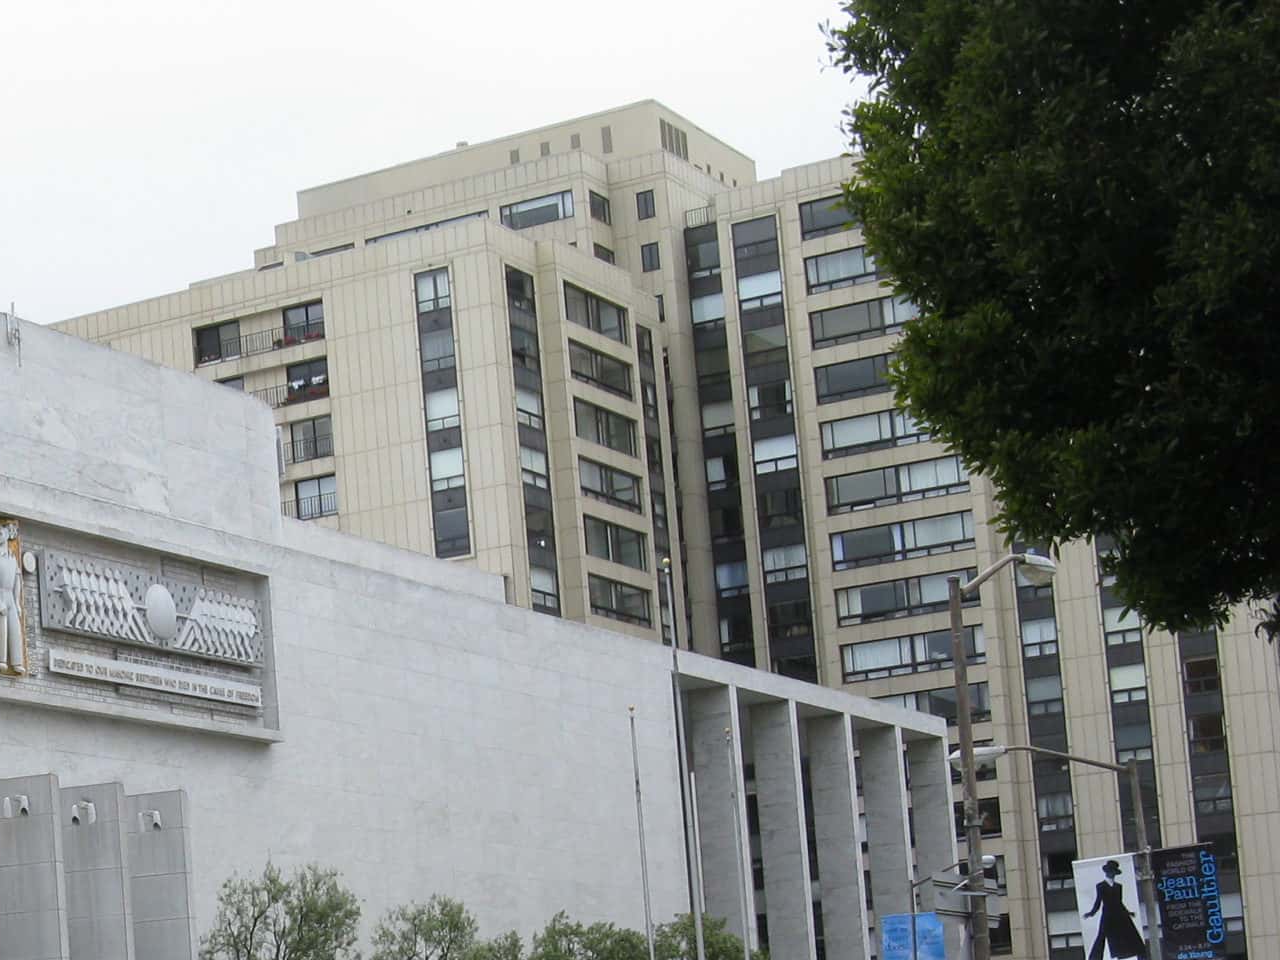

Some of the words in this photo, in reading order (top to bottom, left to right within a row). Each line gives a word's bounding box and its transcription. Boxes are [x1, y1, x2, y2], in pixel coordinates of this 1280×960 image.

[84, 663, 93, 674] TO
[1157, 875, 1198, 890] Jean
[1164, 886, 1200, 901] Paul
[1200, 850, 1224, 944] Gaultier
